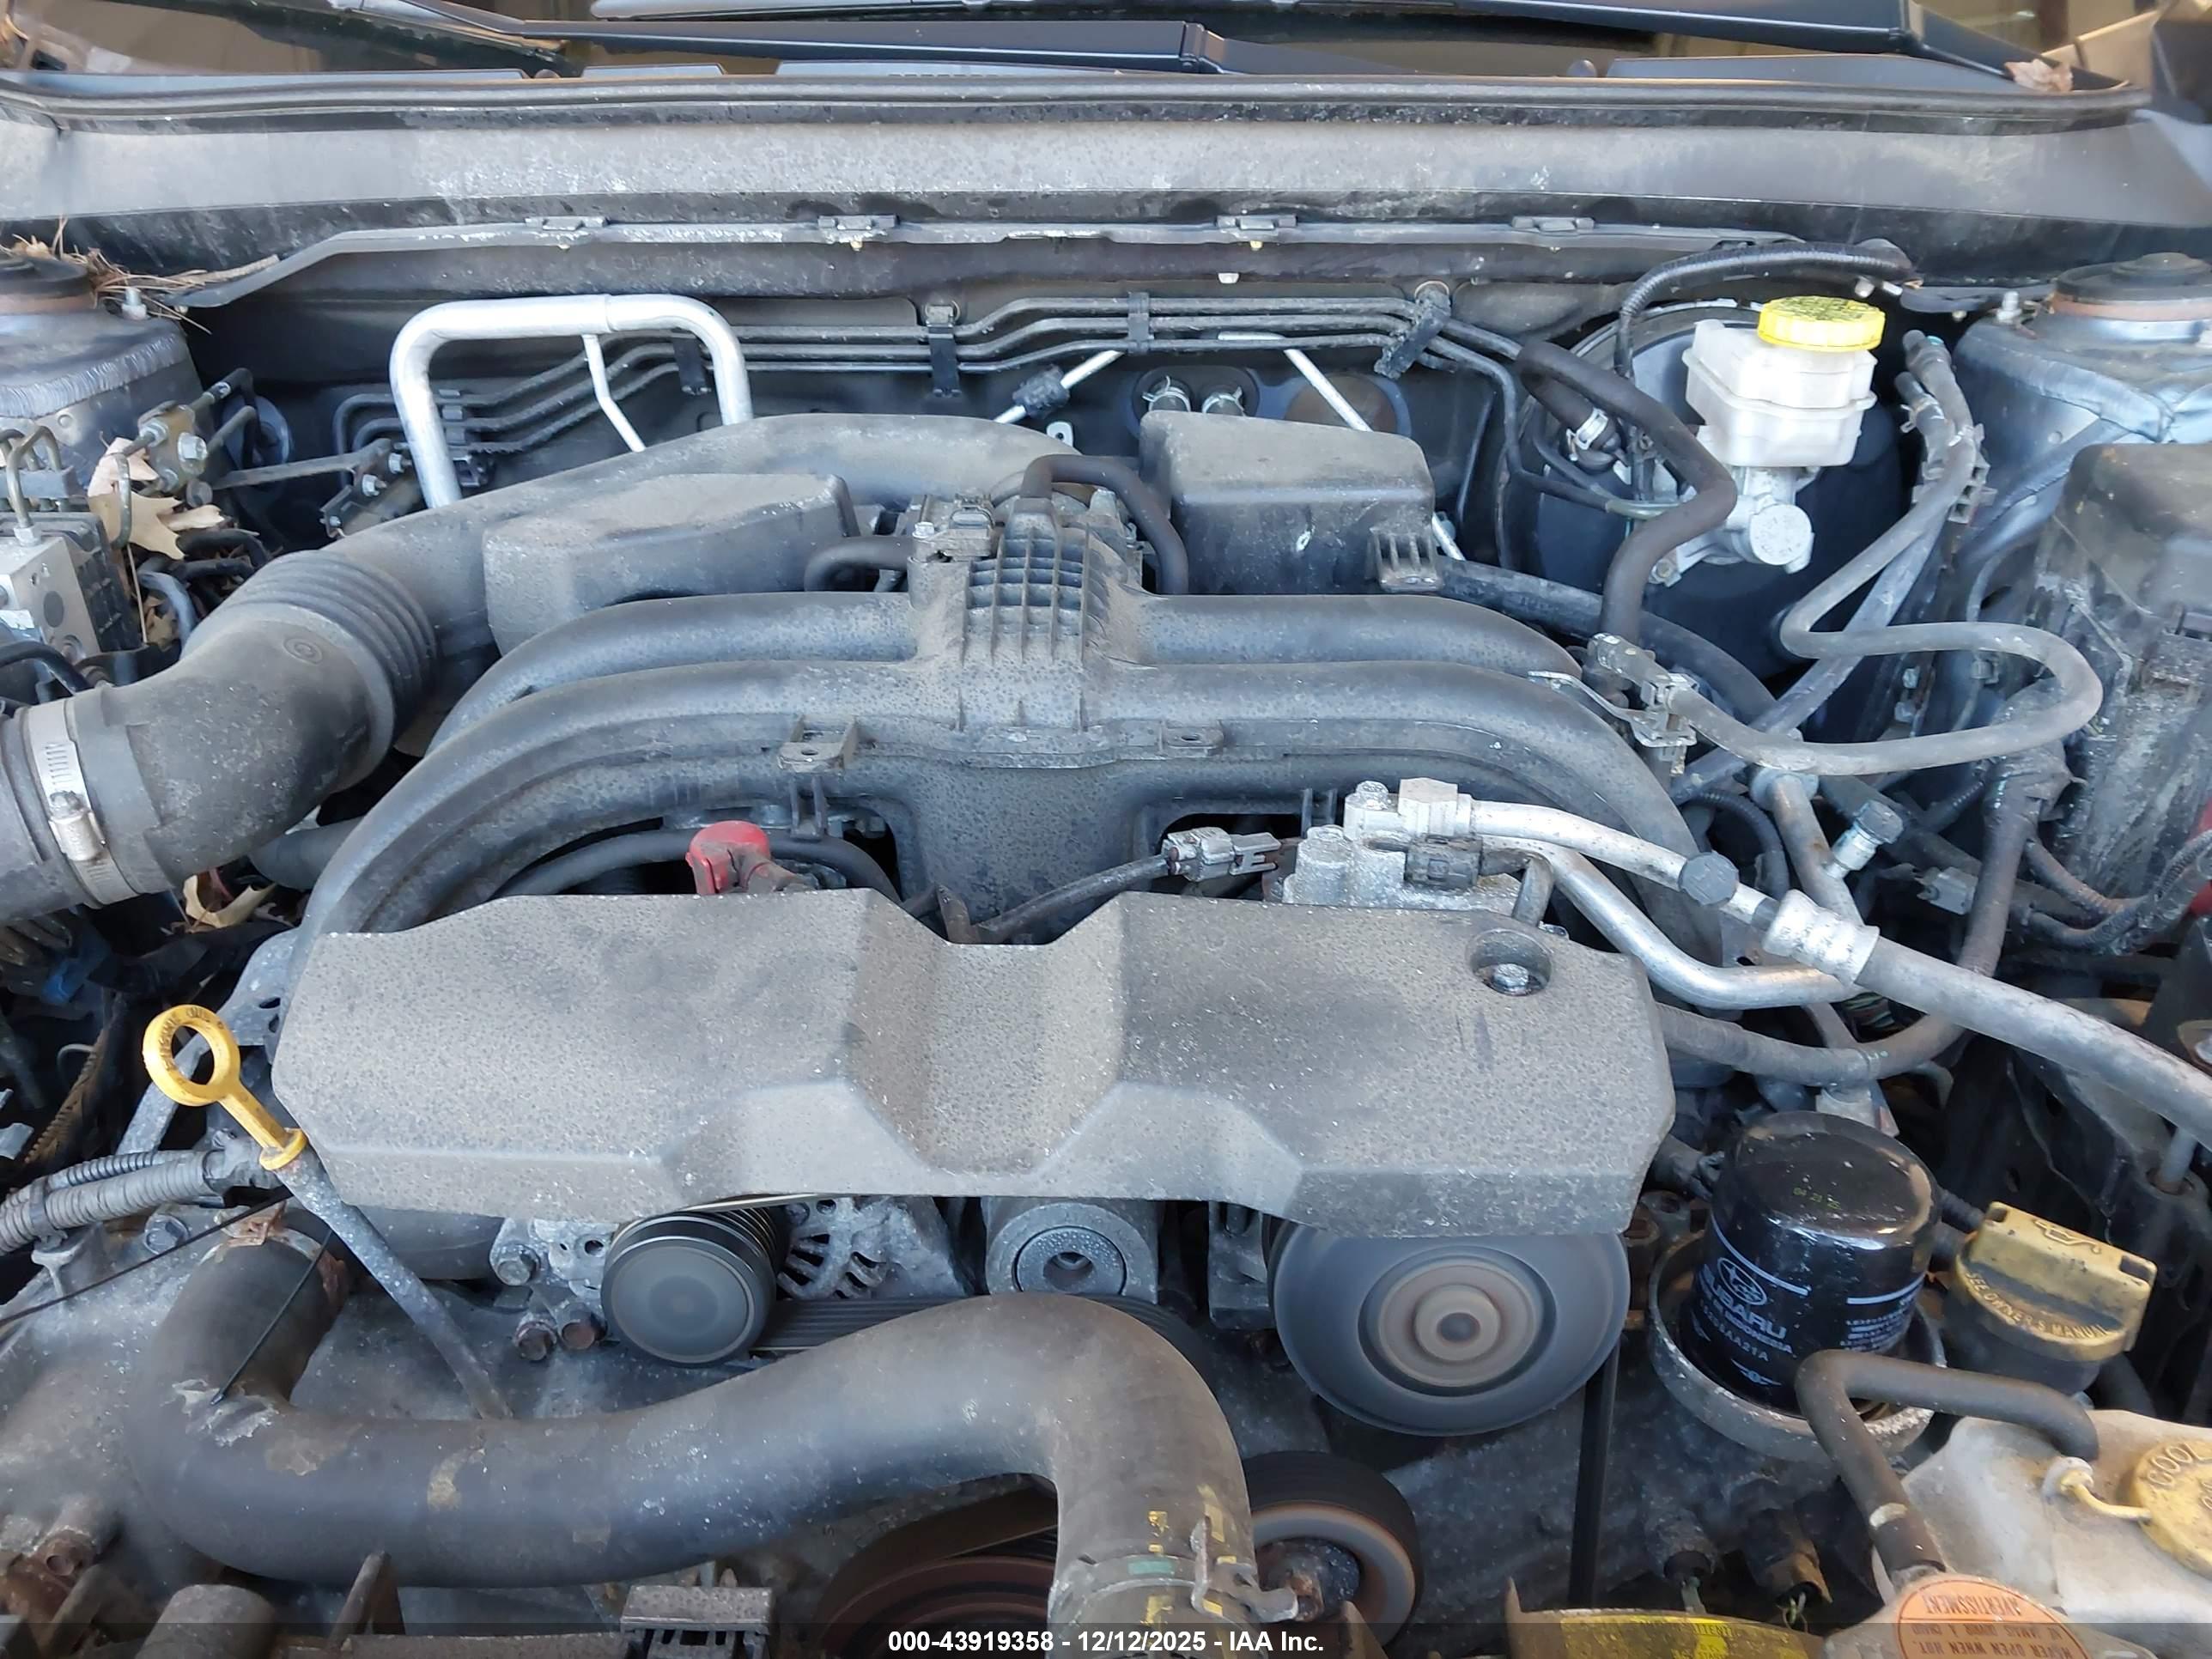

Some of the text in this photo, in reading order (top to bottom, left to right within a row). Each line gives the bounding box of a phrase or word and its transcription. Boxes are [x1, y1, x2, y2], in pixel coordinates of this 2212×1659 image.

[1966, 1271, 1991, 1292] SEE
[2051, 1323, 2109, 1340] MANUAL
[1948, 1641, 1987, 1656] WHEN
[1990, 1642, 2025, 1657] OPEN
